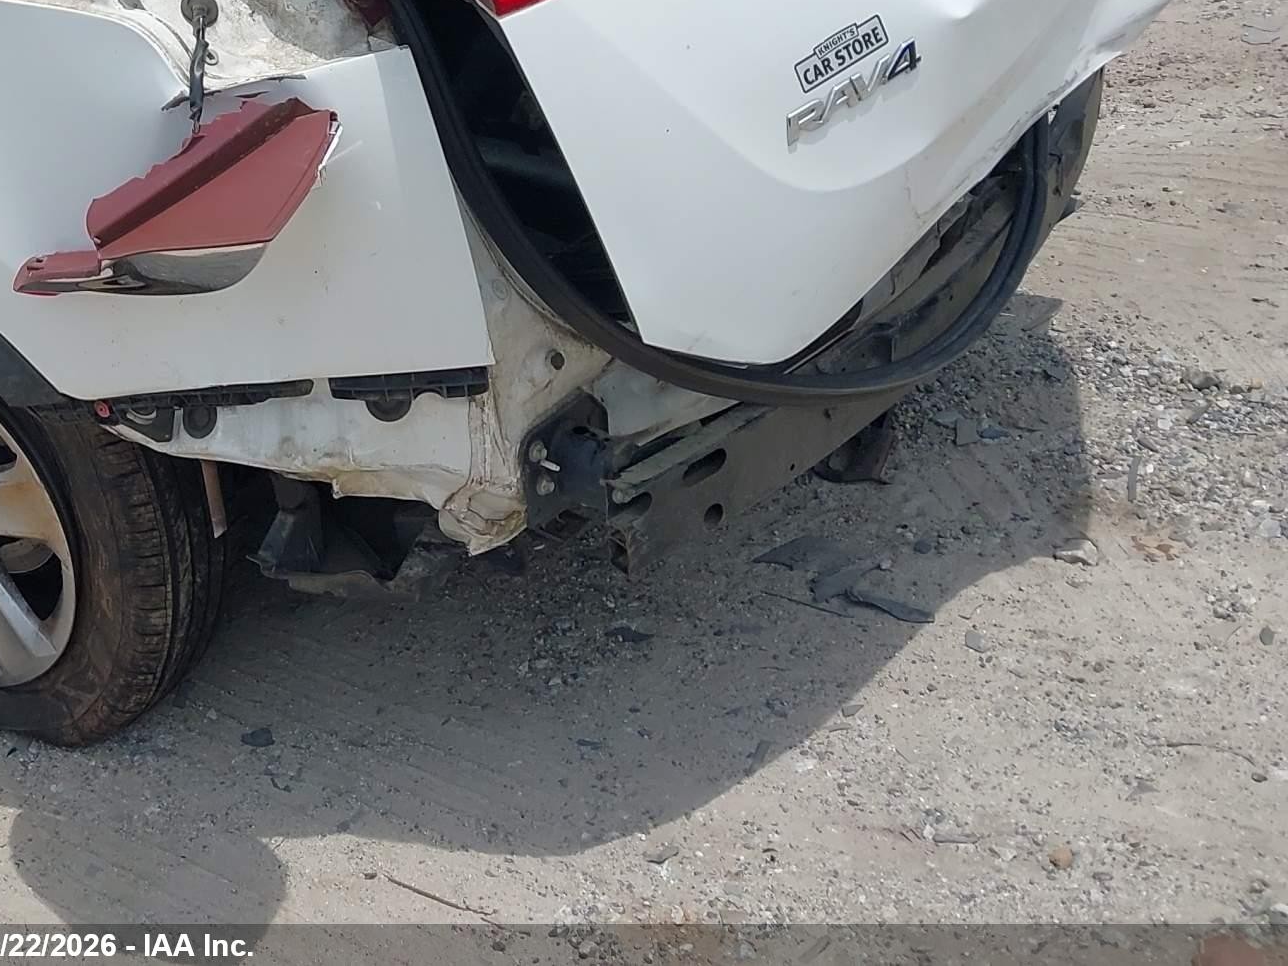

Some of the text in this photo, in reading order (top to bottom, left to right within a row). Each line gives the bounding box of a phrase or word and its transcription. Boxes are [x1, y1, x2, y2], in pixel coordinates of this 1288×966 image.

[803, 26, 883, 85] CAR STORE
[817, 27, 856, 56] KNIGHT'S
[786, 38, 922, 147] RAV4
